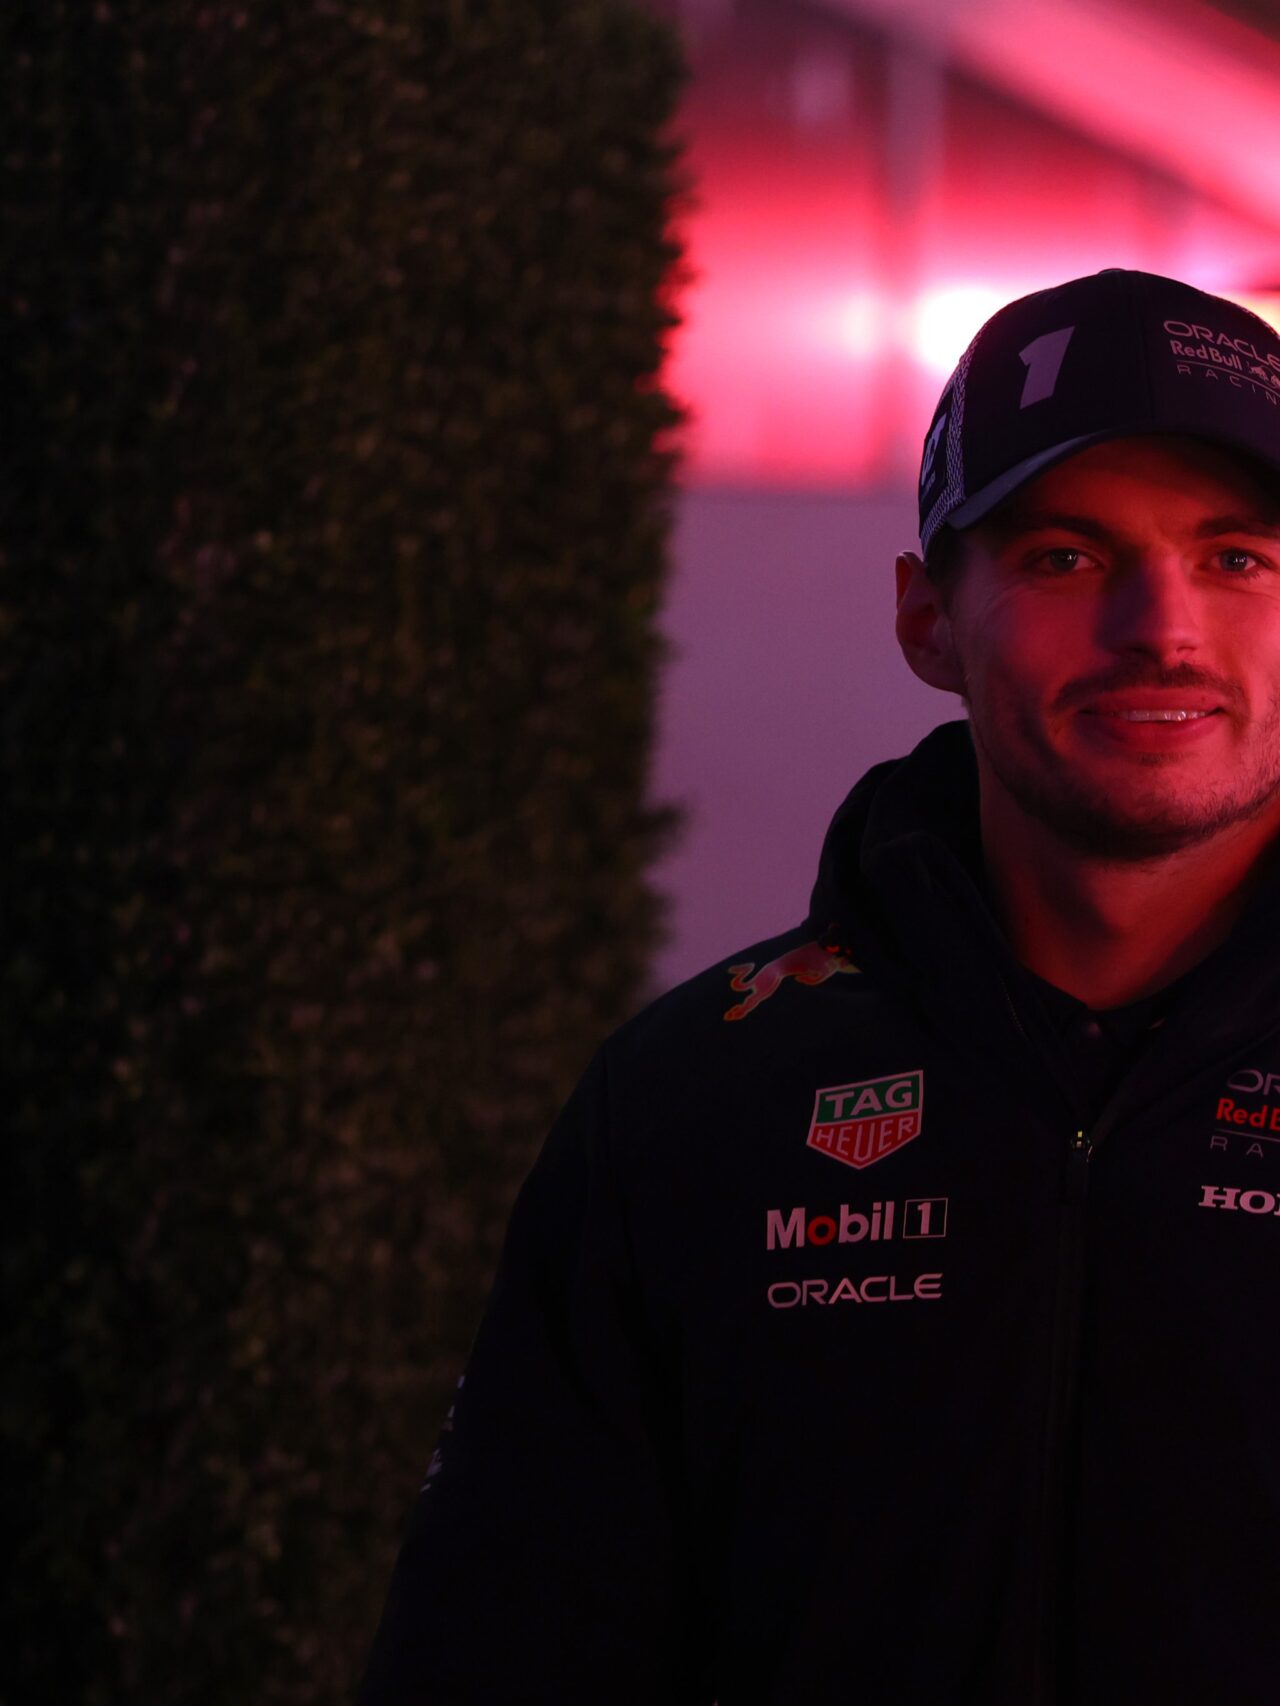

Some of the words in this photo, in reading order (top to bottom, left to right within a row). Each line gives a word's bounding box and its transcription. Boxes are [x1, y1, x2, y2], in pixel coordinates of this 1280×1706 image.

[1017, 325, 1076, 411] 1
[825, 1080, 914, 1119] TAG
[815, 1116, 915, 1161] HEUER
[765, 1201, 896, 1251] Mobil
[766, 1272, 944, 1309] ORACLE
